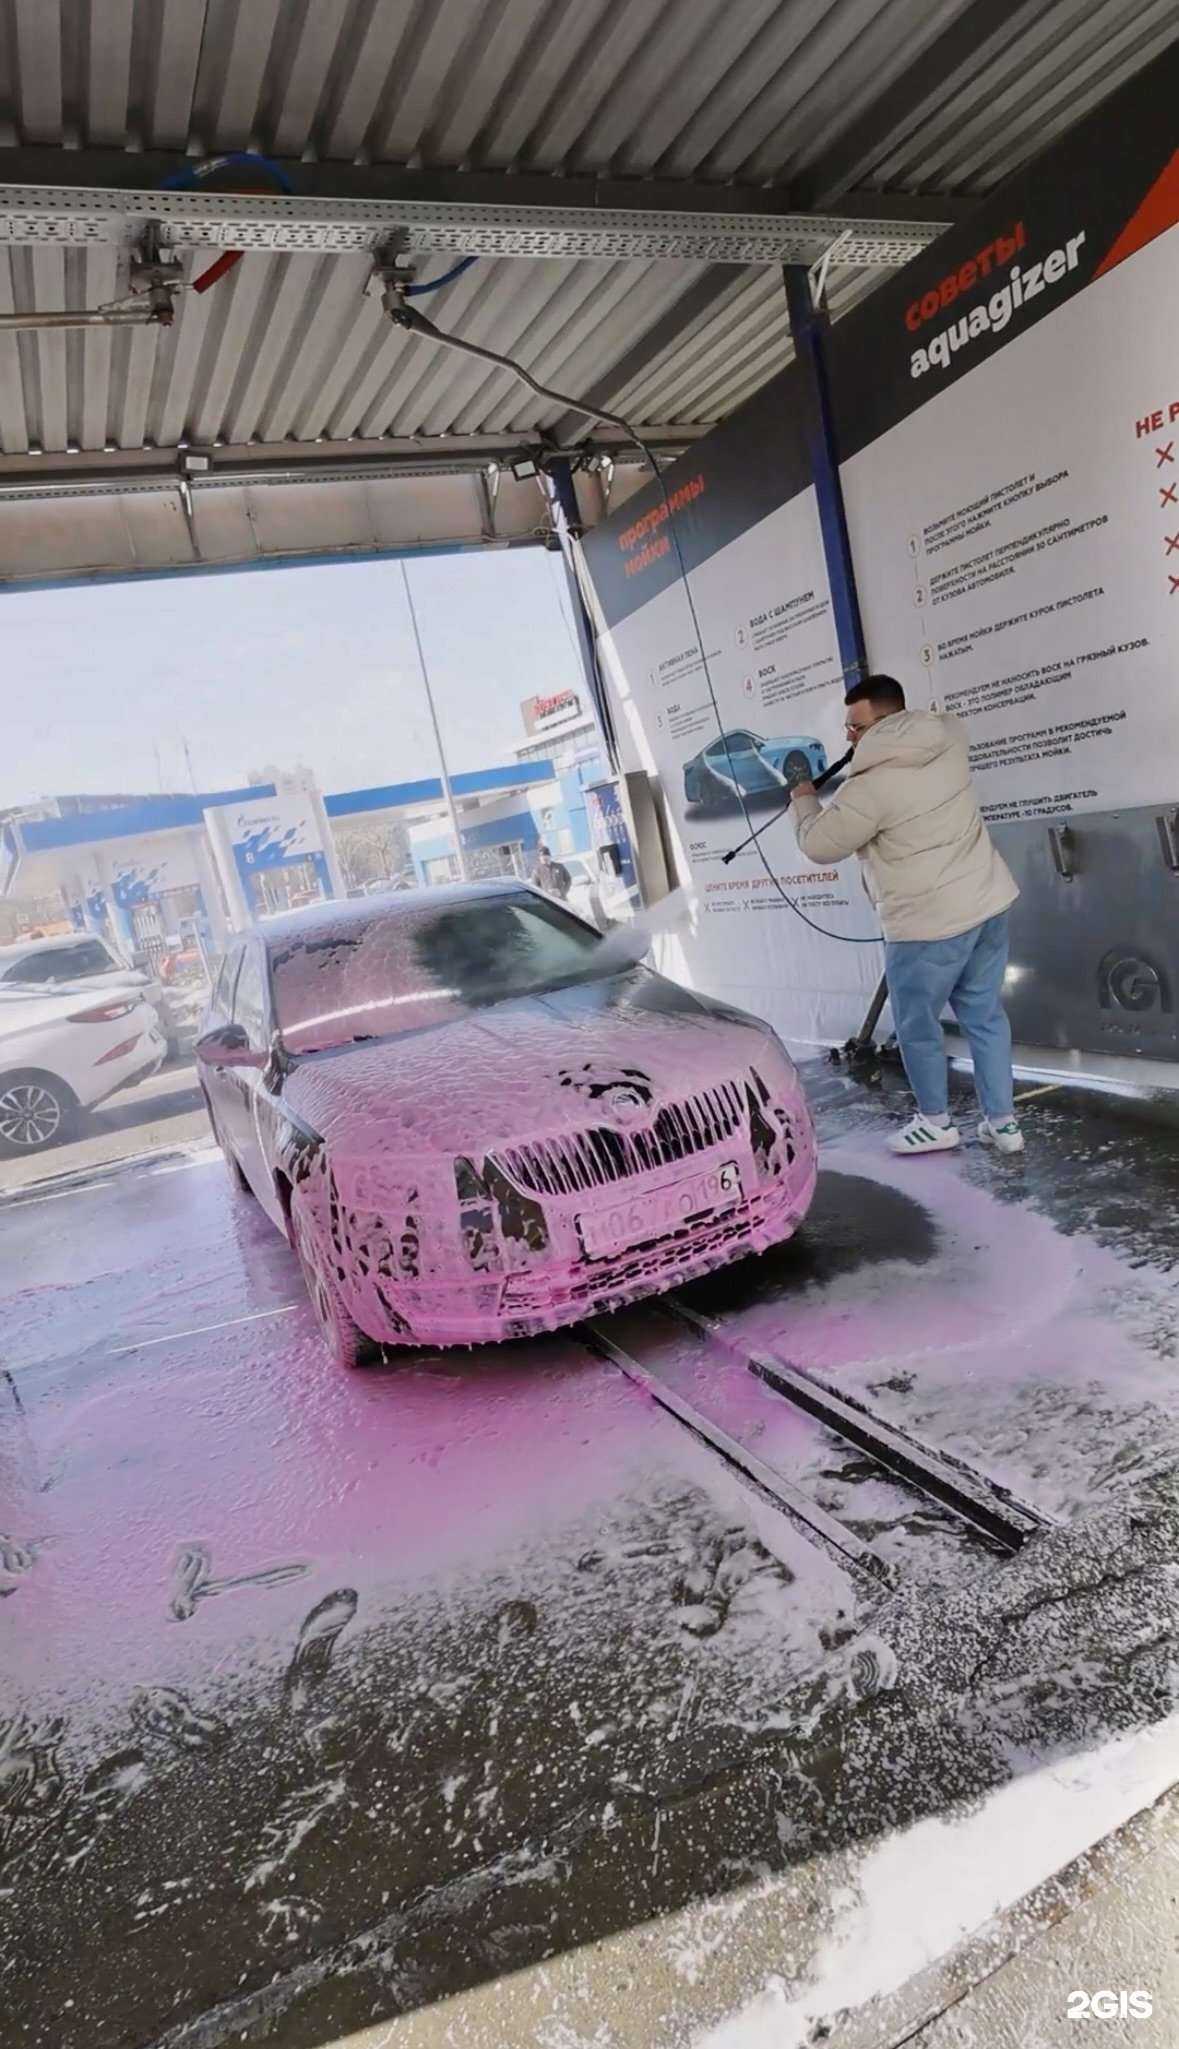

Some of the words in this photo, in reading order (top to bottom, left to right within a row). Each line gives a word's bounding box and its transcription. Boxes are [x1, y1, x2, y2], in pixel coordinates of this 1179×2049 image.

[905, 221, 1027, 331] советы
[911, 230, 1086, 378] aquagizer
[1136, 410, 1164, 439] НЕ
[619, 473, 704, 551] программы
[923, 513, 956, 535] ВОЗЬМИТЕ
[957, 494, 989, 516] МОЮЩИЙ
[991, 477, 1028, 501] ПИСТОЛЕТ
[1029, 473, 1036, 482] И
[924, 532, 946, 546] ПОСЛЕ
[947, 520, 967, 535] ЭТОГО
[968, 502, 1002, 524] НАЖМИТЕ
[1004, 486, 1034, 506] КНОПКУ
[1035, 470, 1069, 491] ВЫБОРА
[926, 535, 965, 555] ПРОГРАММЫ
[977, 565, 988, 576] НА
[989, 547, 1035, 571] РАССТОЯНИИ
[1036, 541, 1046, 552] 30
[1047, 515, 1109, 546] САНТИМЕТРОВ
[929, 566, 959, 586] ДЕРЖИТЕ
[960, 551, 994, 571] ПИСТОЛЕТ
[750, 614, 768, 628] ВОДА
[768, 610, 774, 619] С
[774, 590, 815, 617] ШАМПУНЕМ
[941, 586, 967, 603] КУЗОВА
[938, 642, 947, 652] ВО
[948, 635, 968, 648] ВРЕМЯ
[969, 626, 993, 641] МОЙКИ
[994, 614, 1029, 633] ДЕРЖИТЕ
[1029, 605, 1055, 620] КУРОК
[1056, 587, 1105, 610] ПИСТОЛЕТА
[758, 664, 776, 678] ВОСК
[944, 683, 990, 701] РЕКОМЕНДУЕМ
[991, 680, 1000, 688] НЕ
[1001, 670, 1040, 685] НАНОСИТЬ
[1041, 663, 1062, 674] ВОСК
[1063, 658, 1075, 667] НА
[1076, 645, 1116, 664] ГРЯЗНЫЙ
[945, 702, 962, 712] ВОСК
[968, 697, 980, 705] ЭТО
[981, 687, 1013, 701] ПОЛИМЕР
[1014, 671, 1072, 693] ОБЛАДАЮЩИМ
[1008, 730, 1047, 744] ПРОГРАММ
[1055, 710, 1126, 733] РЕКОМЕНДУЕМОЙ
[1032, 734, 1073, 749] ПОЗВОЛИТ
[1074, 727, 1112, 743] ДОСТИЧЬ
[1000, 753, 1041, 766] РЕЗУЛЬТАТА
[1009, 800, 1018, 808] НЕ
[1019, 796, 1053, 807] ГЛУШИТЬ
[1054, 789, 1098, 802] ДВИГАТЕЛЬ
[728, 879, 749, 890] ВРЕМЯ
[780, 869, 839, 886] ПОСЕТИТЕЛЕЙ
